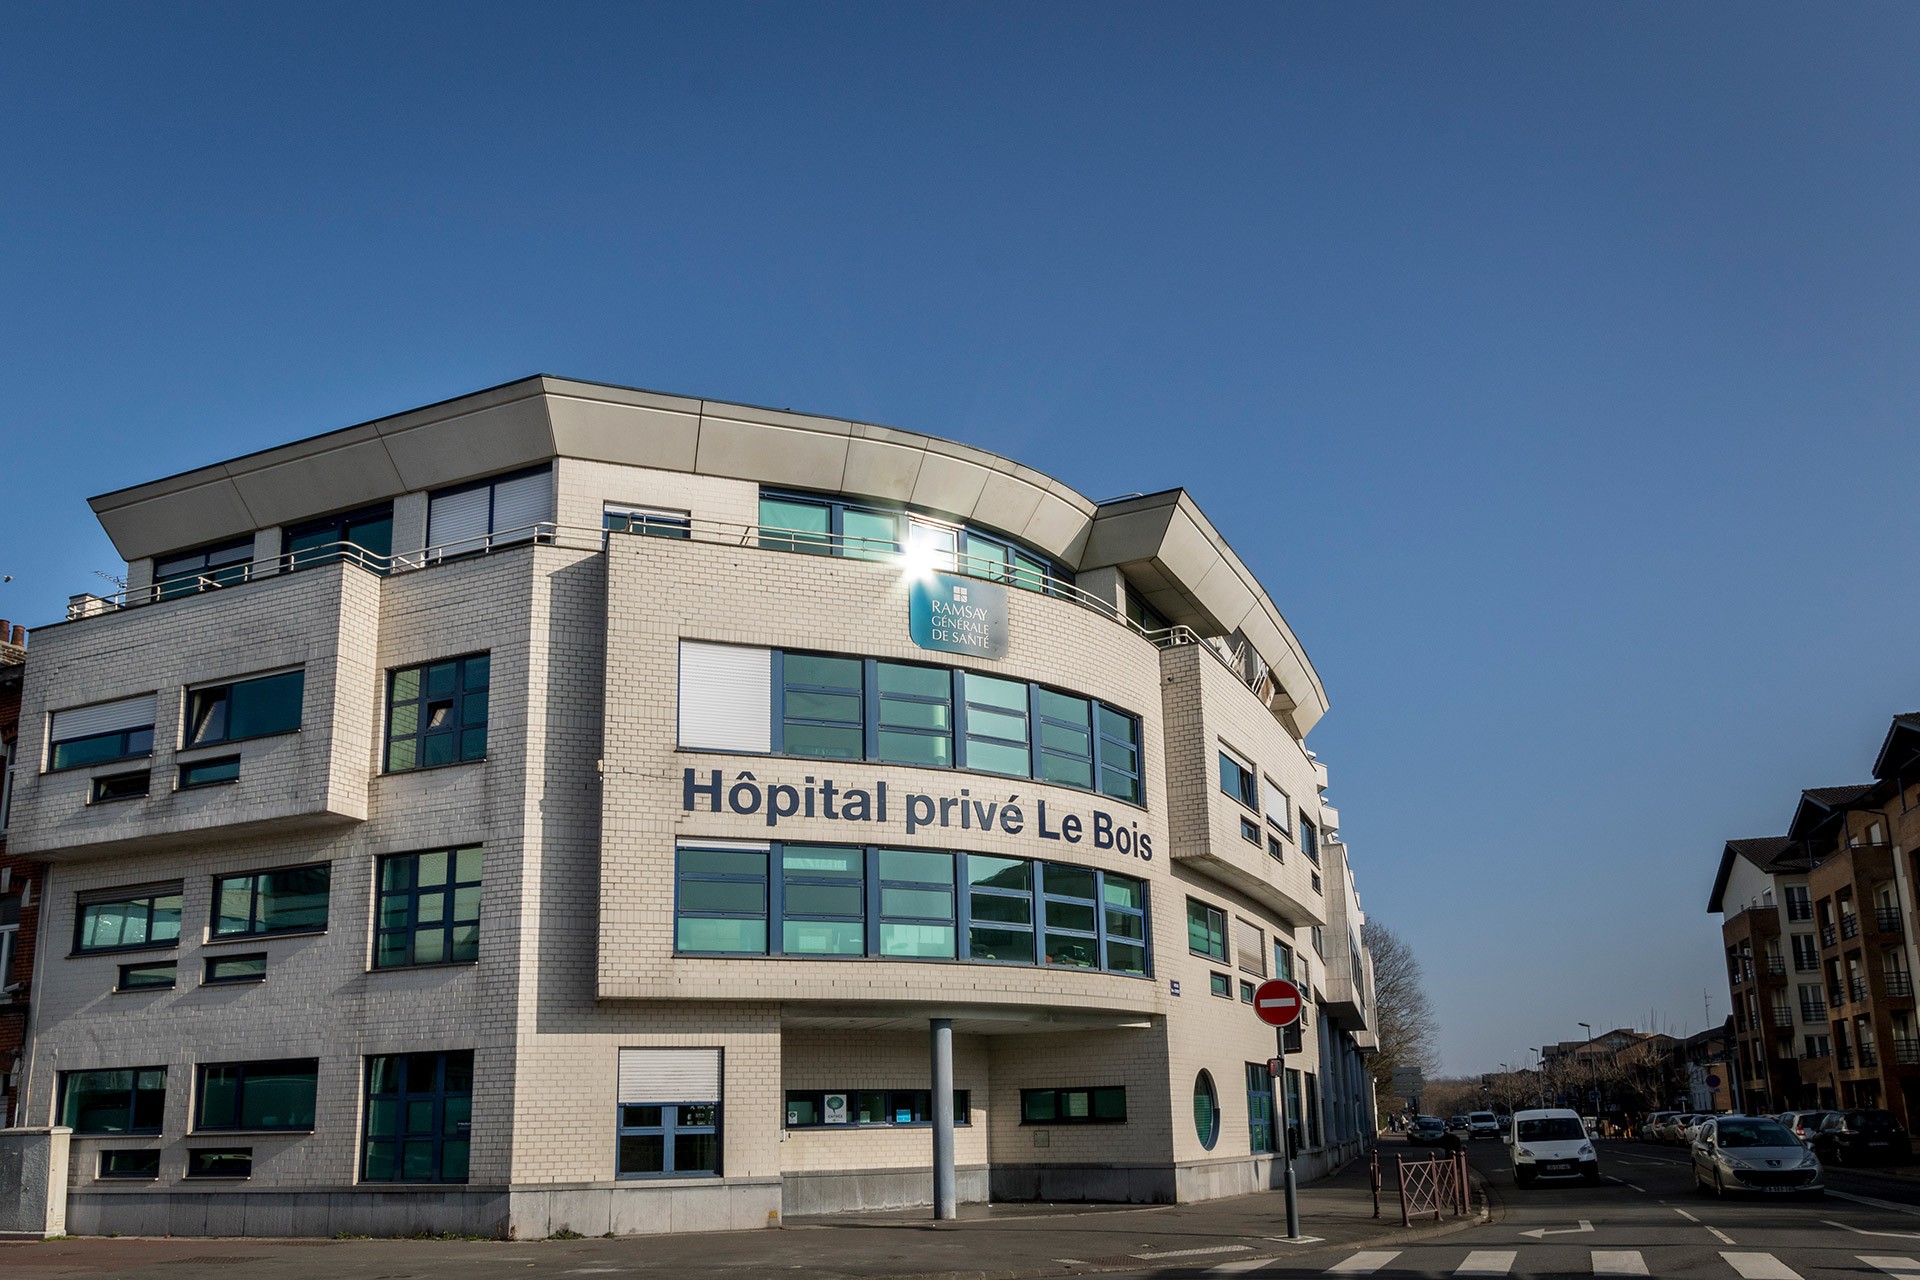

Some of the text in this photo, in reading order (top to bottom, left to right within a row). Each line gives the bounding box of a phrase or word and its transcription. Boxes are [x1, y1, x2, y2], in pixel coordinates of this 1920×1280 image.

[932, 600, 988, 621] RAMSAY
[931, 614, 989, 635] GÉNÉRALE
[932, 629, 989, 649] DE SANTÉ
[683, 768, 1153, 862] Hôpital privé Le Bois
